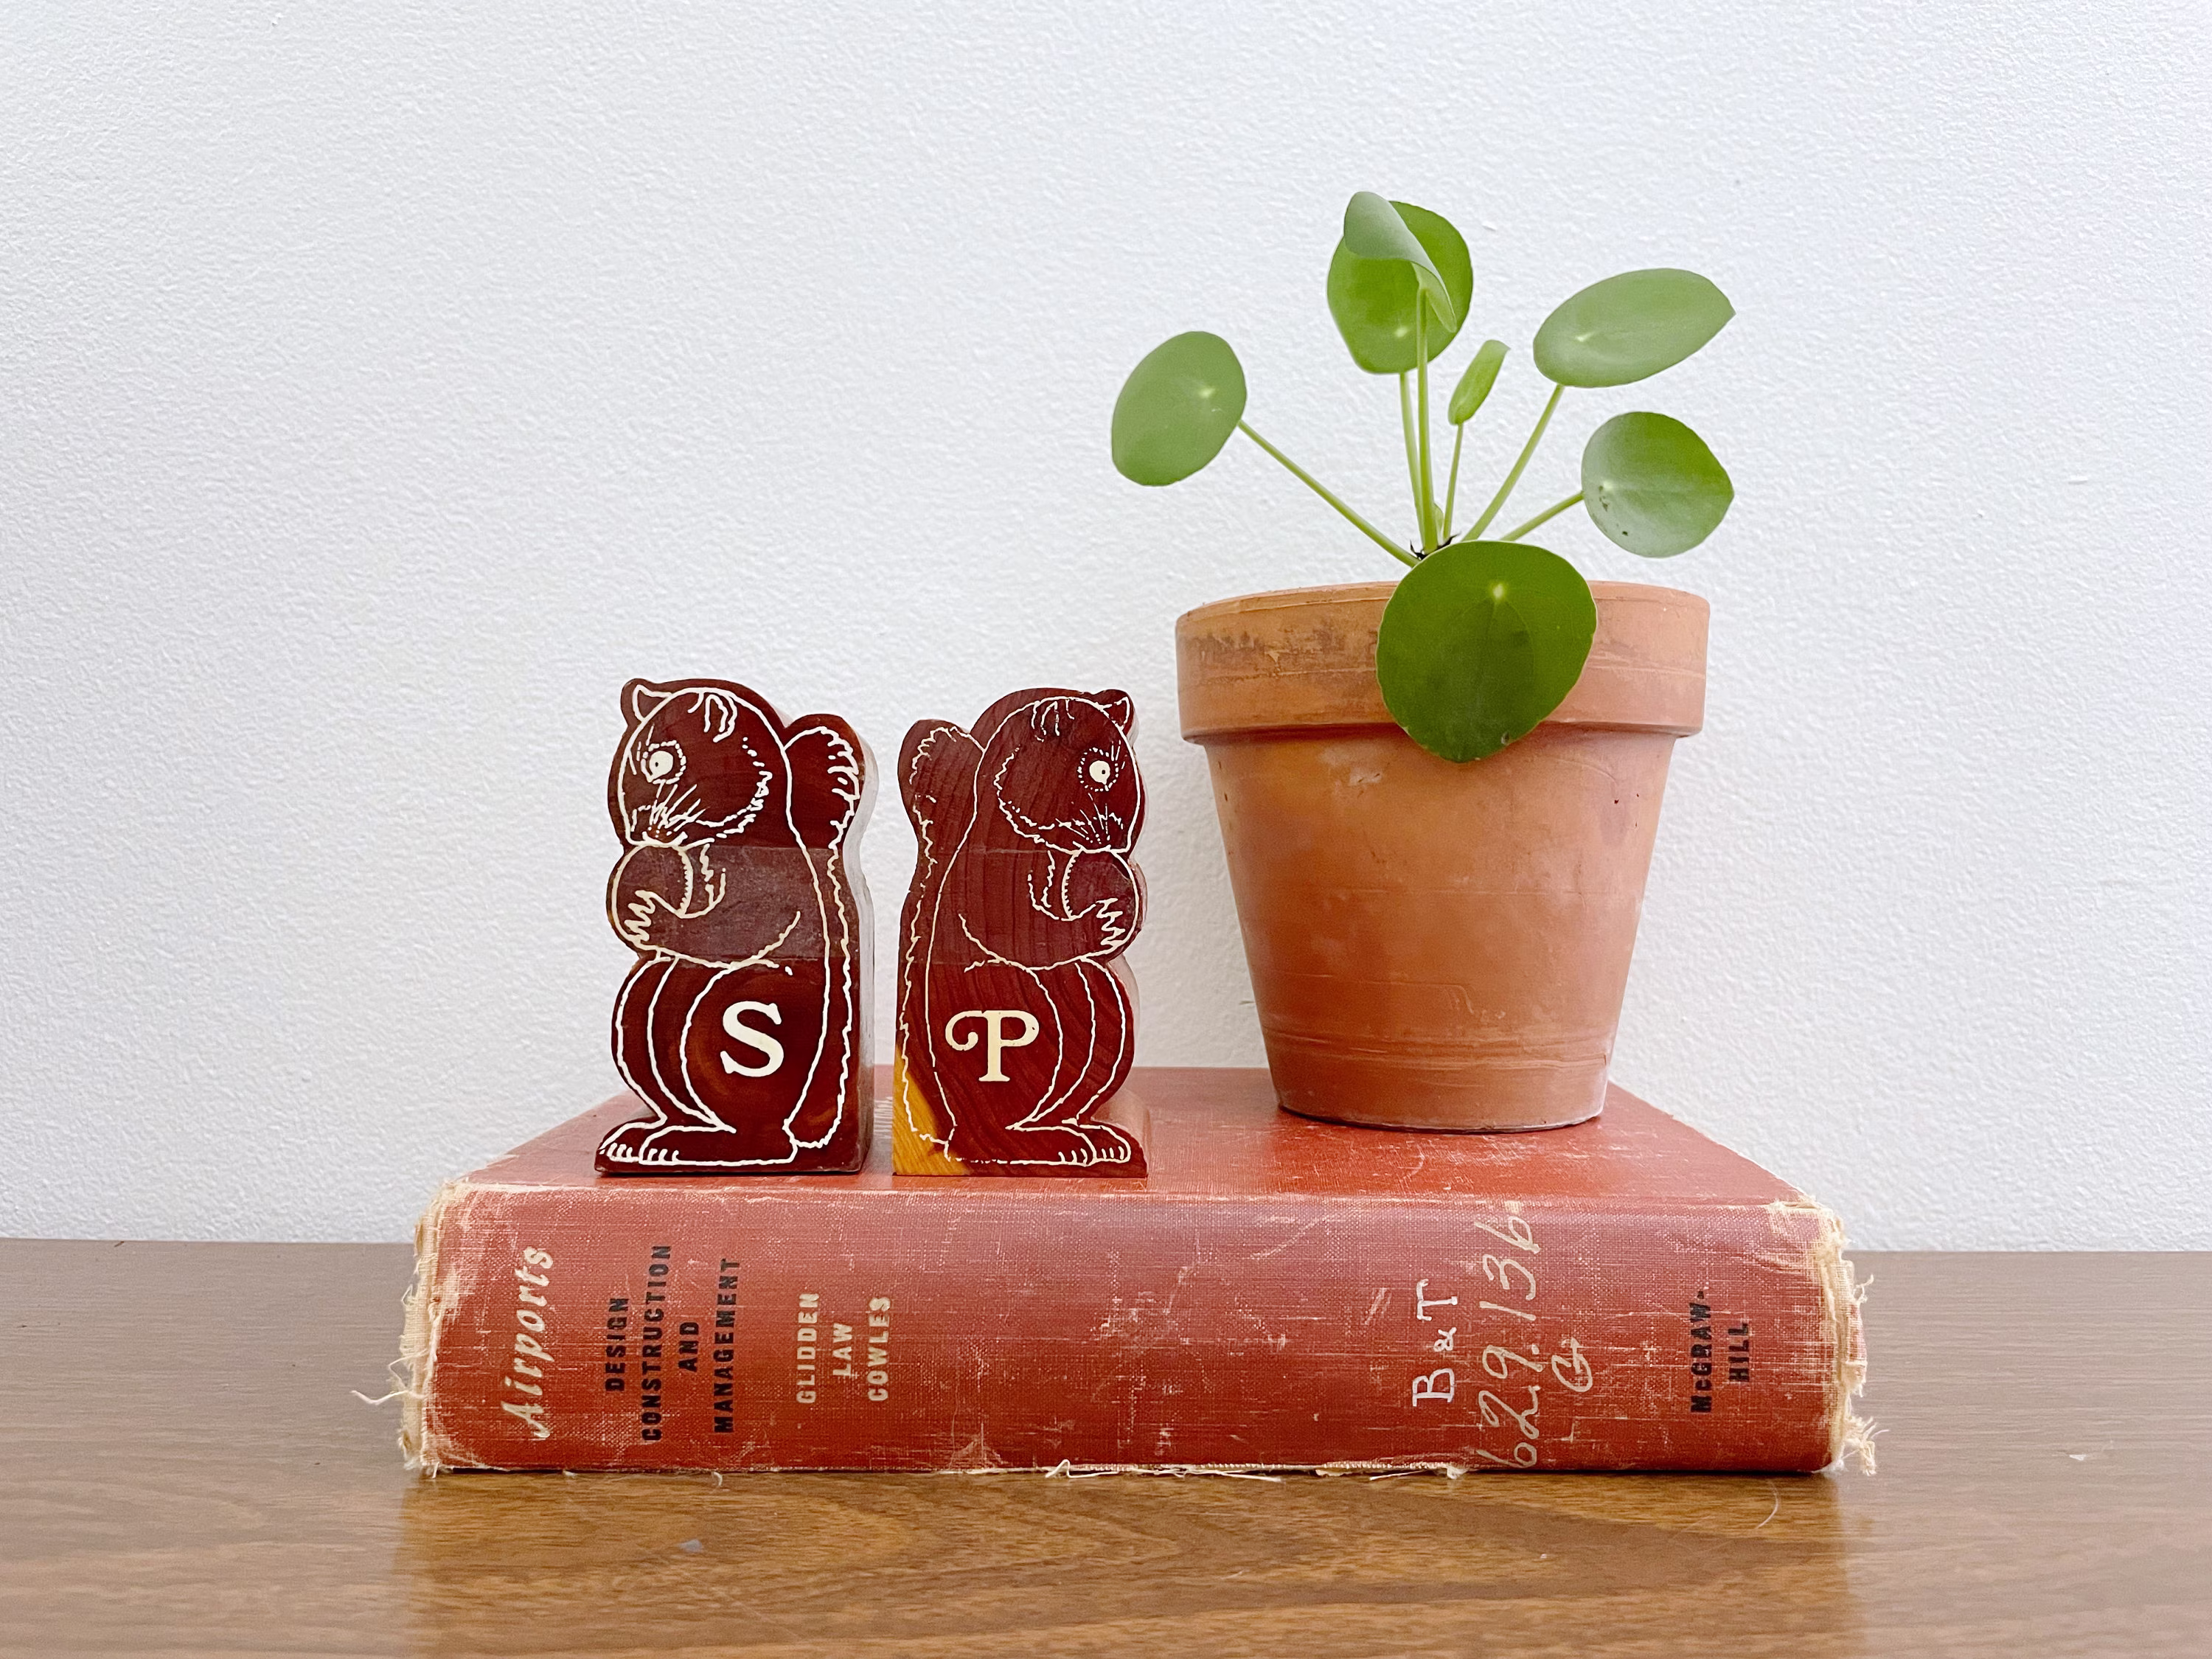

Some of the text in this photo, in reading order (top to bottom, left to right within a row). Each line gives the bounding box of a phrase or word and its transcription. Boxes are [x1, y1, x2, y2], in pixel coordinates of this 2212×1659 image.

[720, 1001, 784, 1077] S
[945, 1010, 1040, 1082] P
[501, 1247, 554, 1439] Airports
[605, 1298, 629, 1392] DESIGN
[641, 1245, 671, 1441] CONSTRUCTION
[678, 1321, 700, 1373] AND
[714, 1258, 740, 1433] MANAGEMENT
[796, 1293, 819, 1404] GLIDDEN
[833, 1323, 852, 1377] LAW
[868, 1295, 891, 1401] COWLES
[1475, 1216, 1544, 1468] 629.136
[1728, 1322, 1750, 1382] HILL
